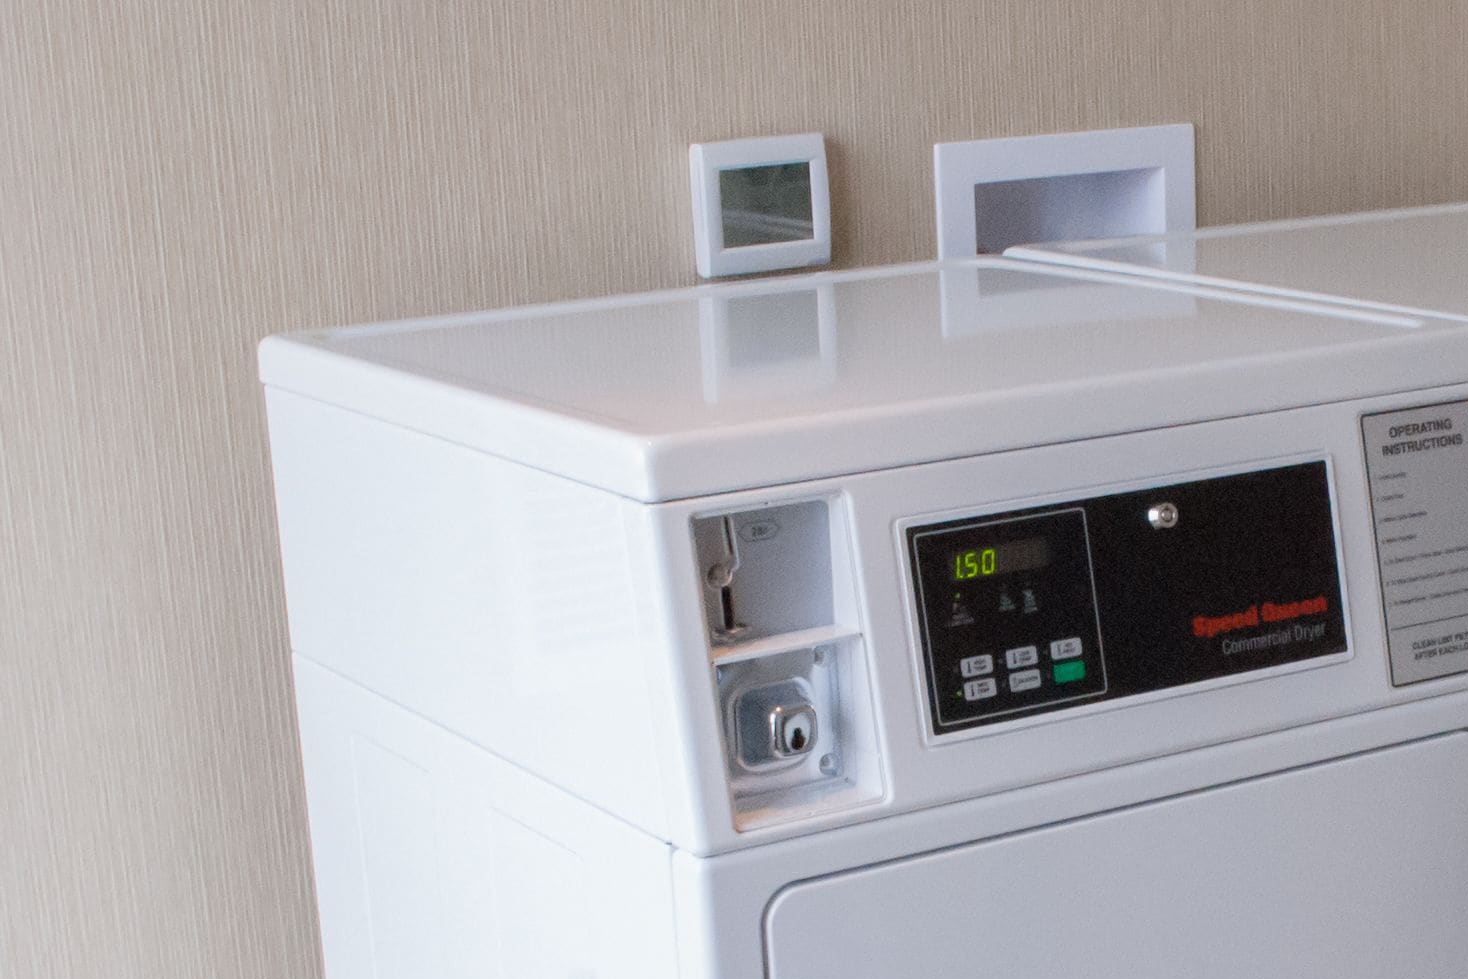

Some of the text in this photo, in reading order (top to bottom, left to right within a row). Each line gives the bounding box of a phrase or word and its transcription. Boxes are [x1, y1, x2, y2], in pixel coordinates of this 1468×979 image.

[1389, 418, 1452, 438] OPERATING
[1382, 433, 1463, 456] INSTRUCTIONS
[1222, 623, 1326, 655] Commercial Dryer
